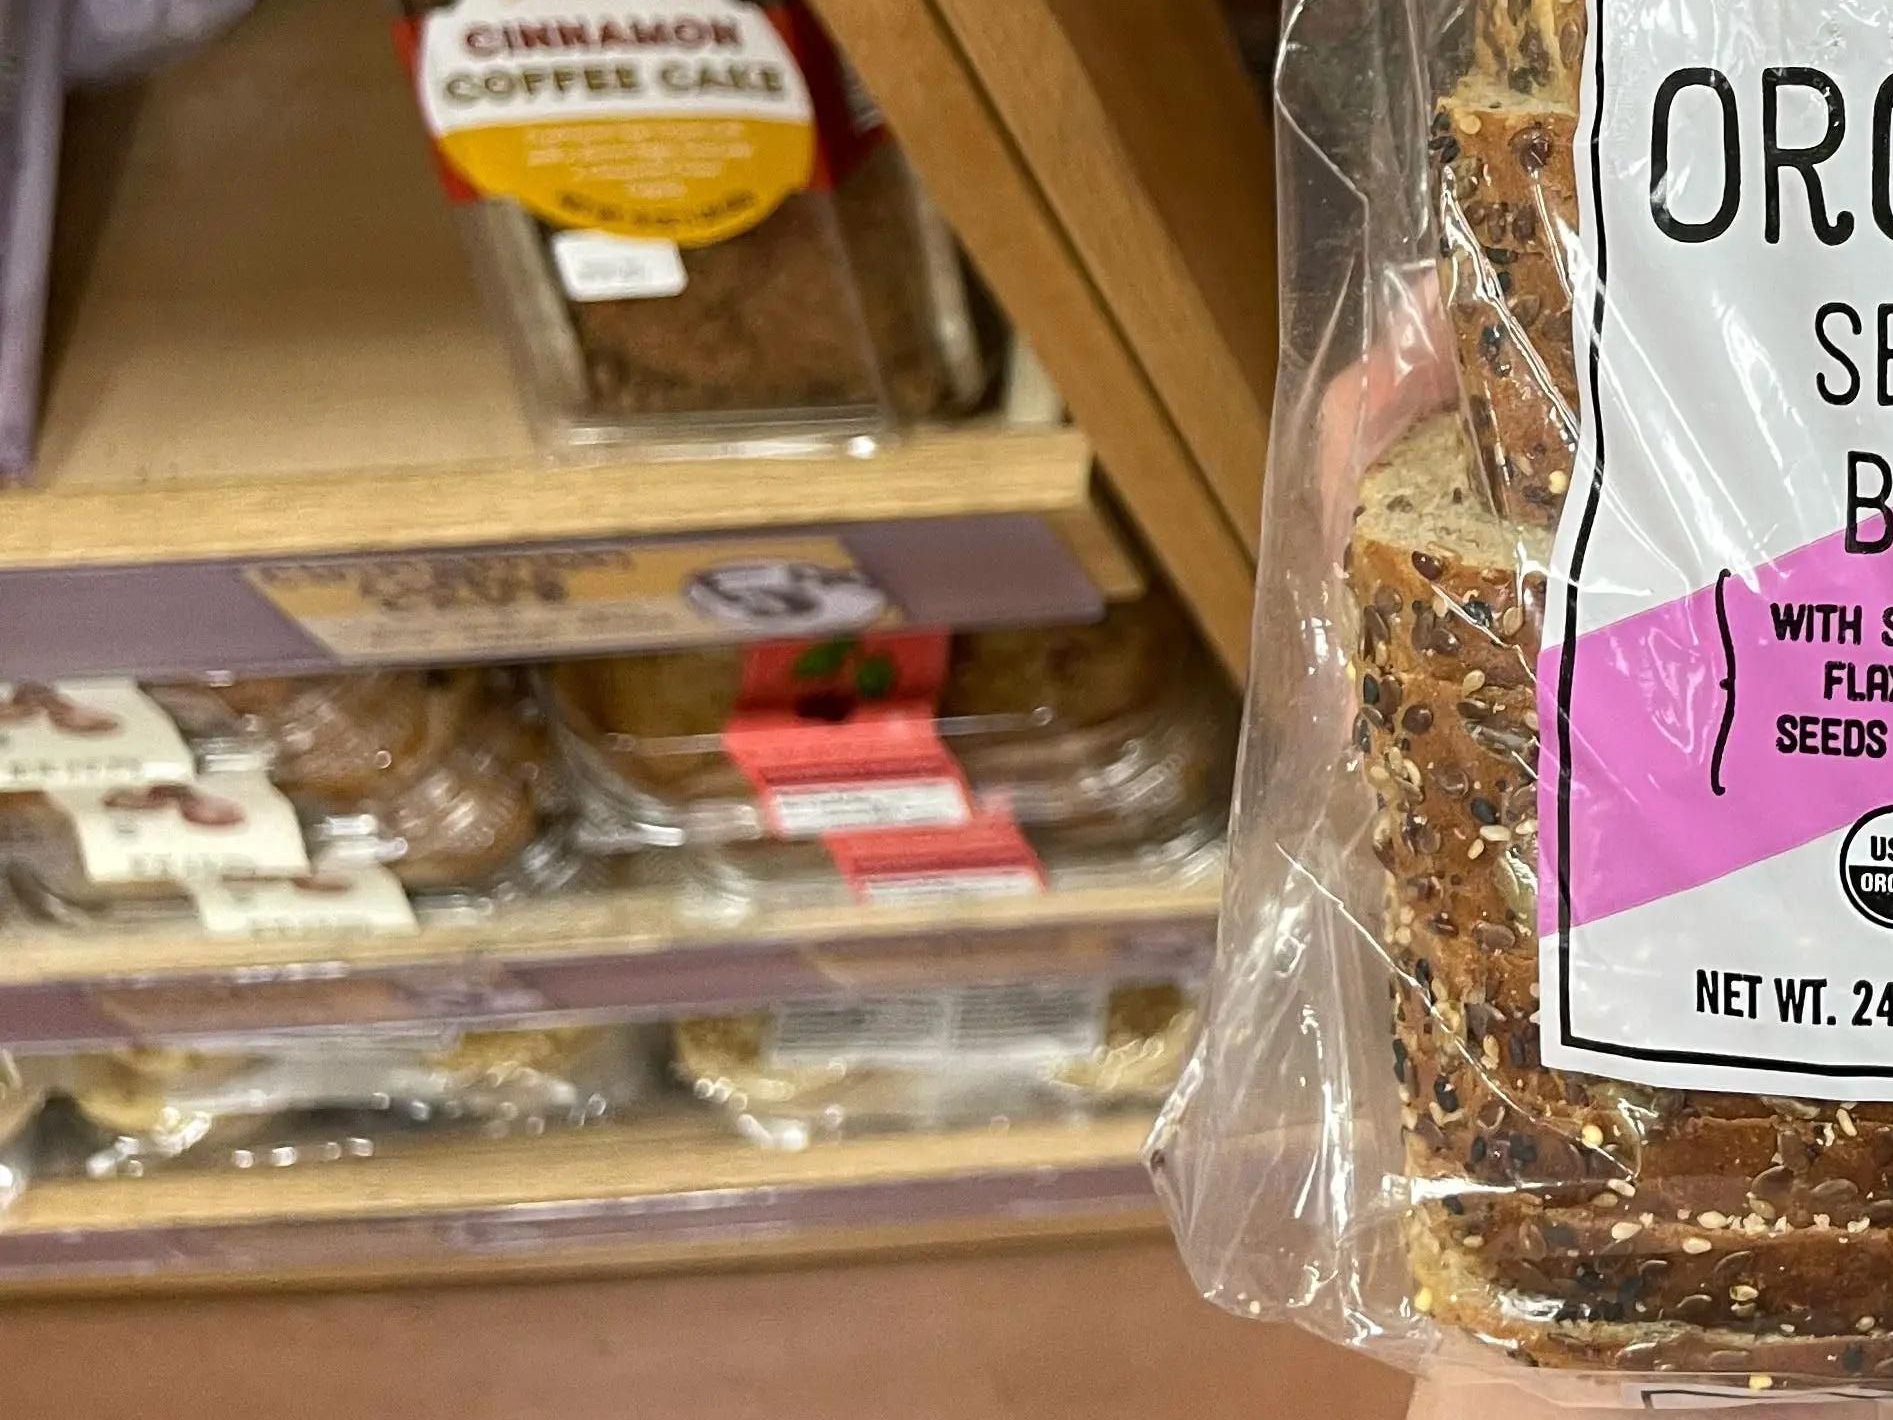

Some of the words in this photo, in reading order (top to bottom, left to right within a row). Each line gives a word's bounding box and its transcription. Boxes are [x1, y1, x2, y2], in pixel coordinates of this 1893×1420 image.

[466, 14, 742, 58] CINNAMON
[444, 62, 640, 108] COFFEE
[660, 60, 785, 94] CAKE
[1770, 602, 1862, 646] WITH
[1775, 714, 1888, 759] SEEDS
[1696, 969, 1763, 1020] NET
[1773, 978, 1837, 1026] WT.
